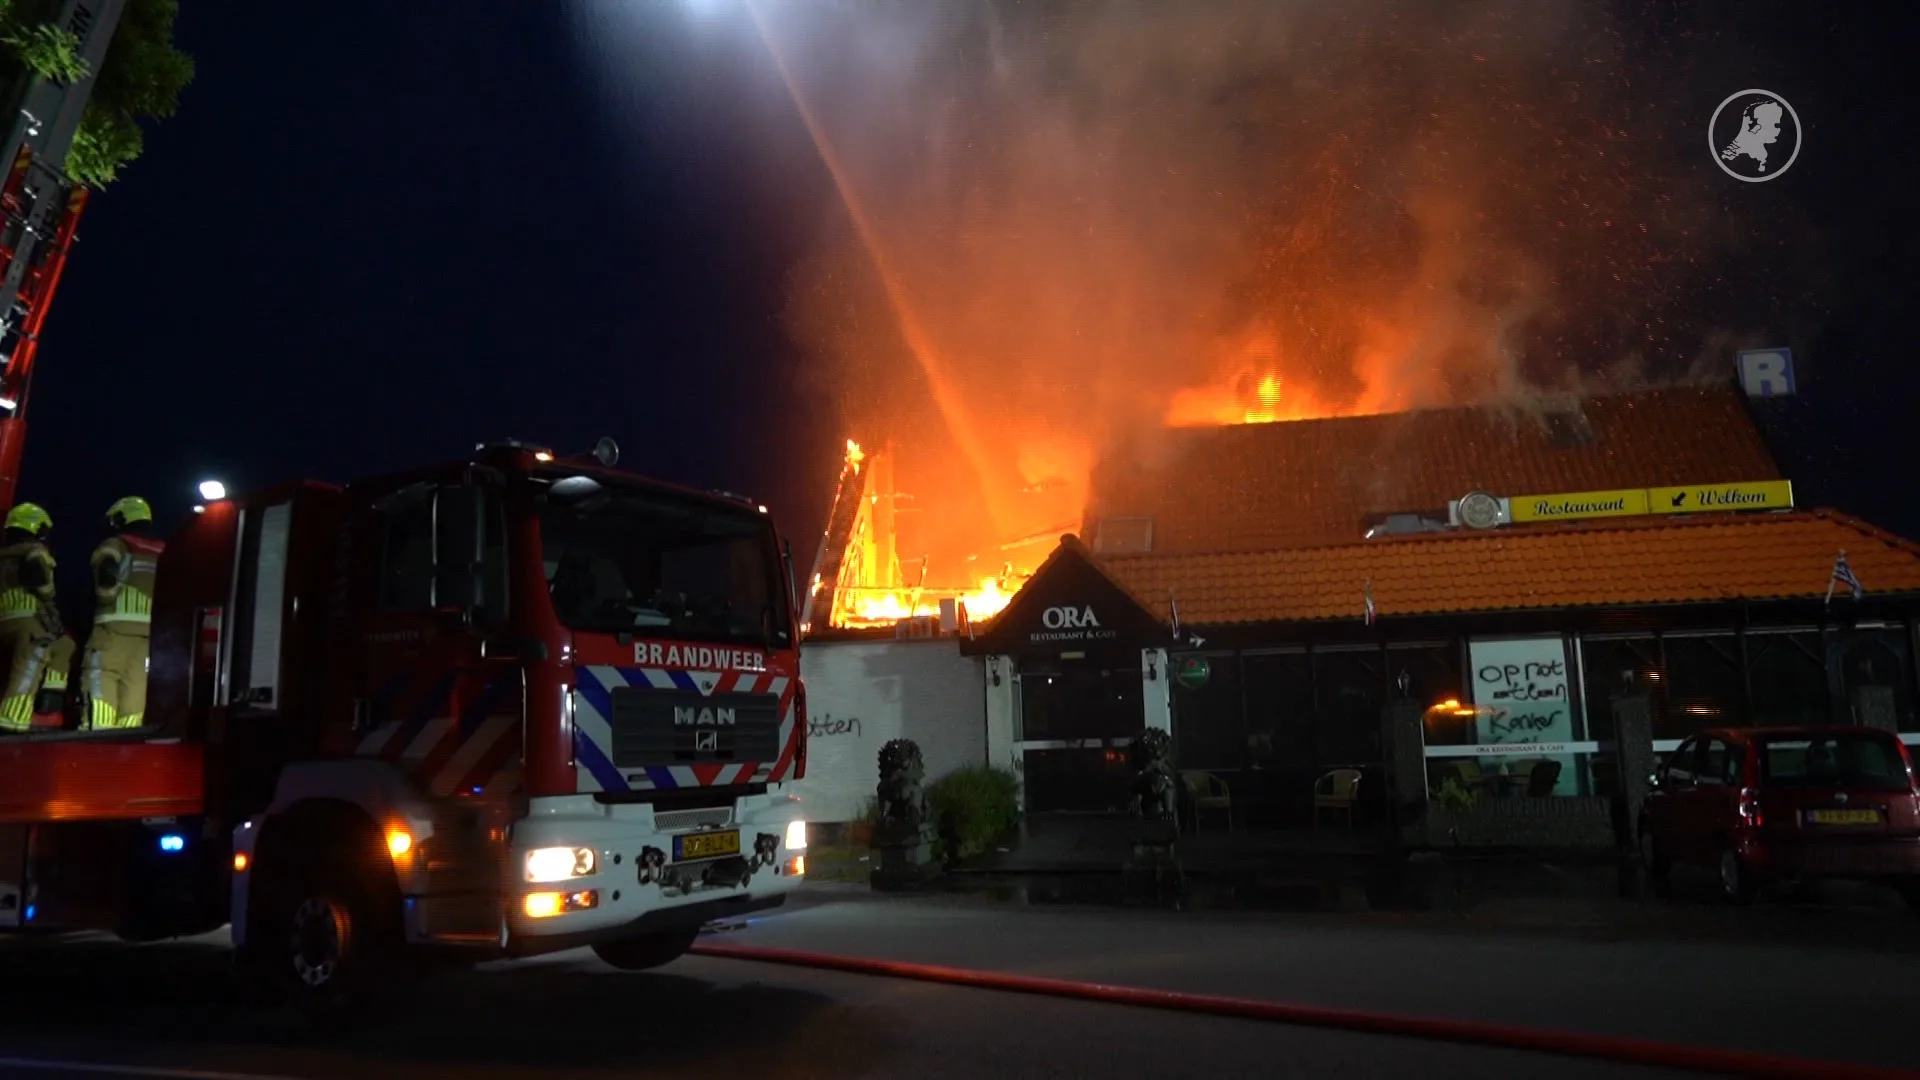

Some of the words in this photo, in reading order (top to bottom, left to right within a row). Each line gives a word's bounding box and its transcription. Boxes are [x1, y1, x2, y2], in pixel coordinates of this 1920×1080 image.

[1742, 352, 1788, 397] R
[1533, 498, 1625, 516] Restaurant
[1697, 488, 1766, 506] Welkom
[1042, 604, 1101, 629] ORA
[1030, 631, 1085, 642] RESTAURANT
[633, 641, 767, 671] BRANDWEER
[673, 705, 736, 726] MAN
